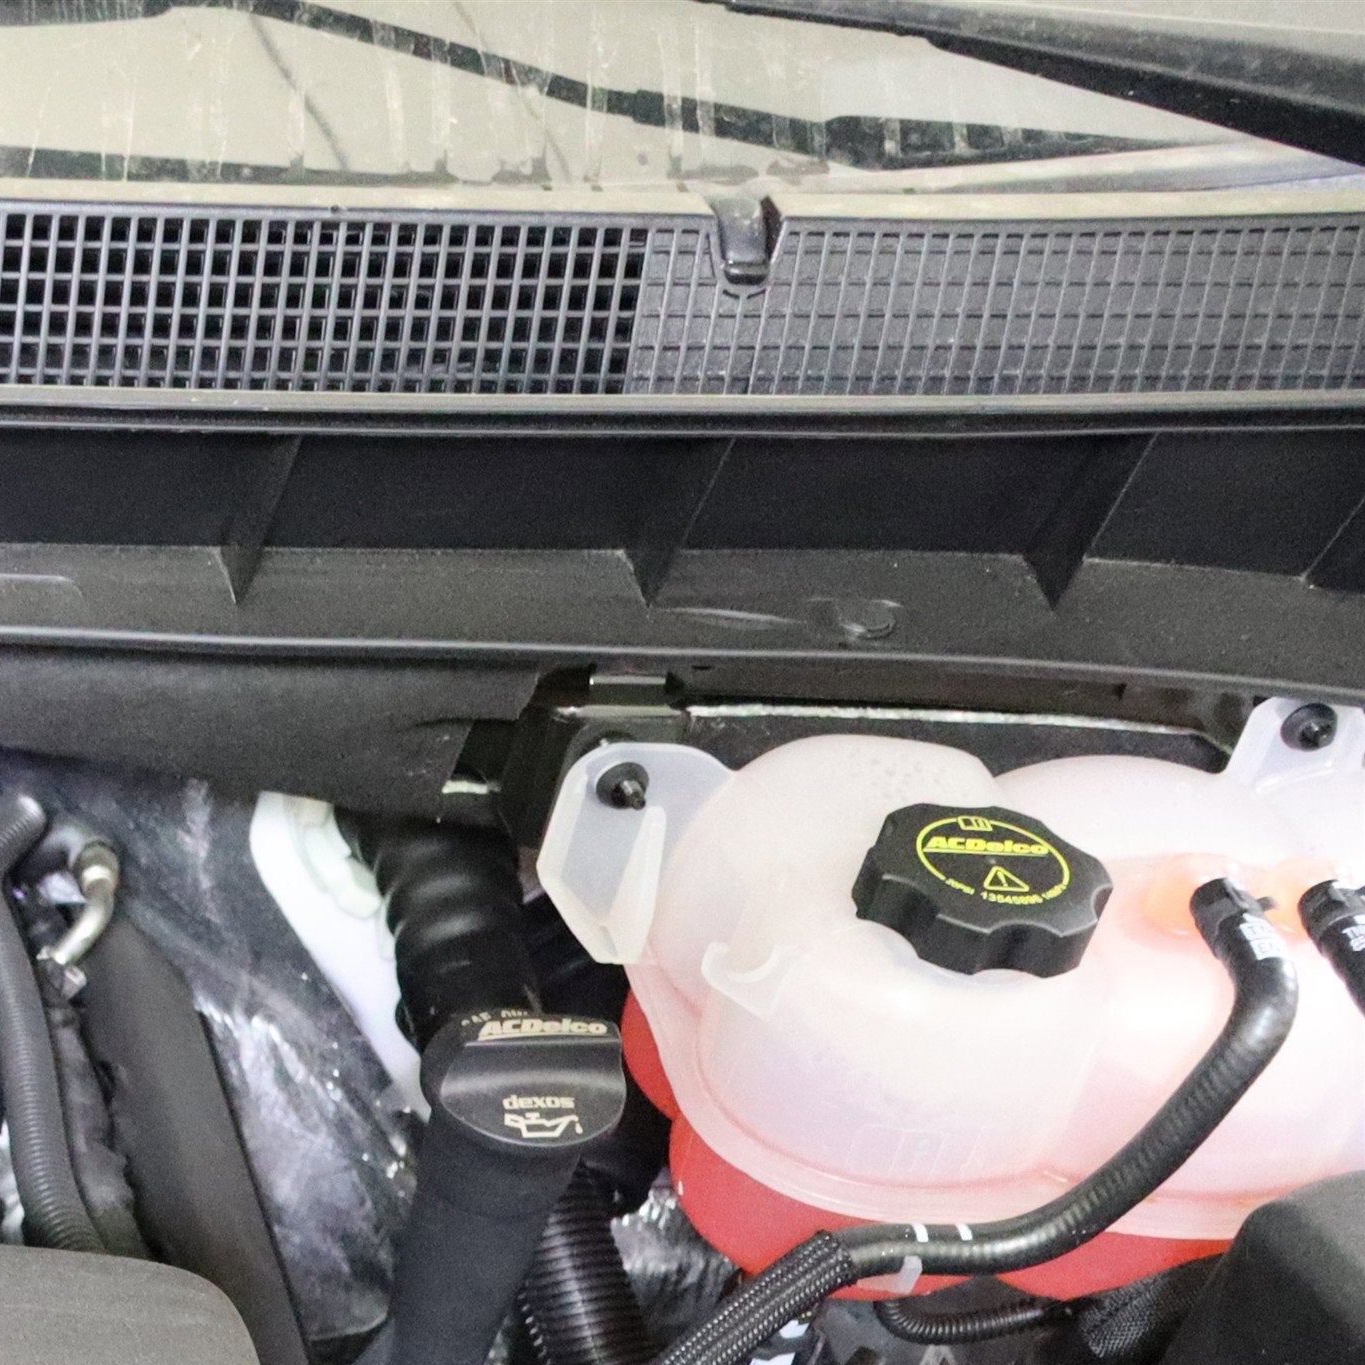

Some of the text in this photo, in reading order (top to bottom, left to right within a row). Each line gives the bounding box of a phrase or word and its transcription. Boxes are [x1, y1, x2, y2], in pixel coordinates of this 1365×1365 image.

[925, 836, 1049, 855] ACDelco
[478, 1017, 608, 1036] ACDelco
[502, 1094, 576, 1110] dexos
